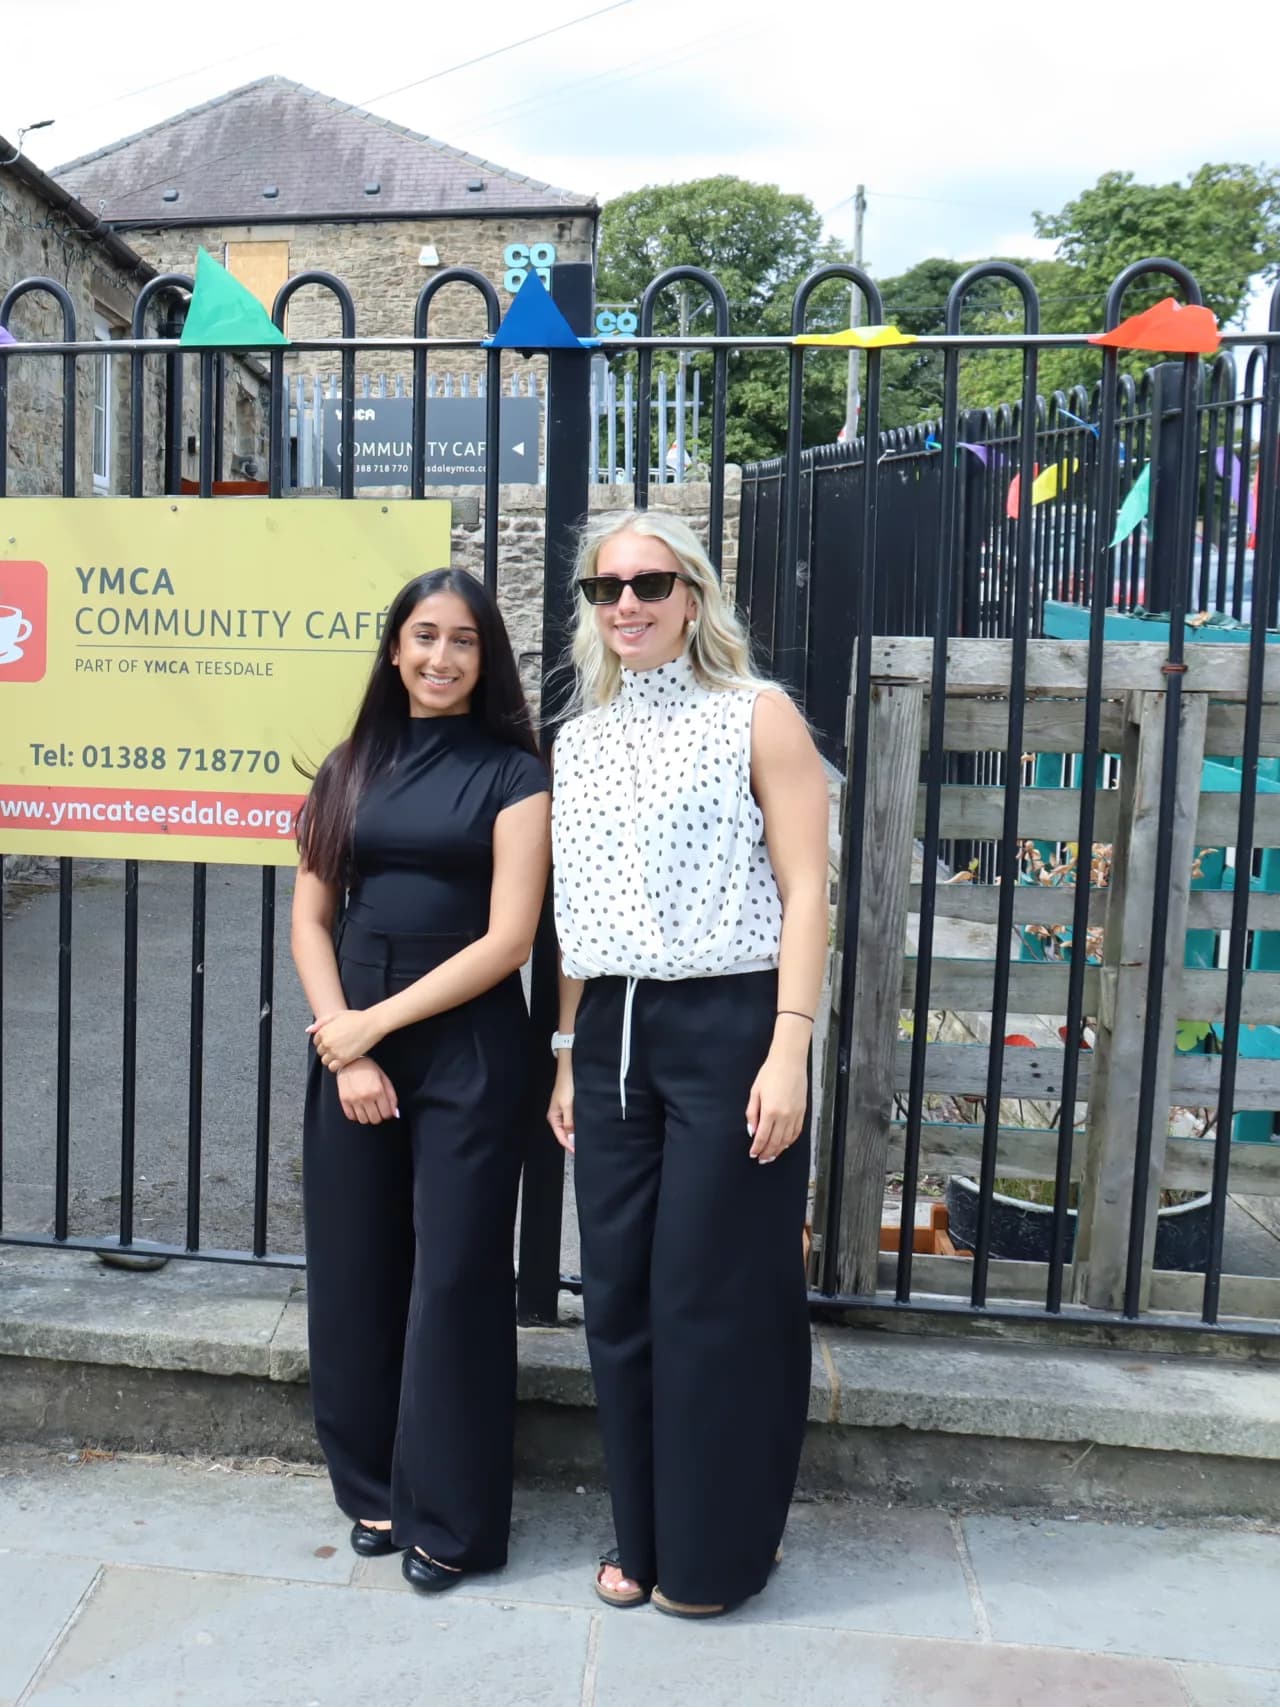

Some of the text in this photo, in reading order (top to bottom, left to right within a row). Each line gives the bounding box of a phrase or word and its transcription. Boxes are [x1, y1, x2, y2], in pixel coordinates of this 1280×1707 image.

[335, 408, 375, 421] YCA
[452, 441, 487, 457] CAF
[391, 464, 408, 473] 770
[75, 566, 175, 596] YMCA
[75, 606, 292, 639] COMMUNITY
[75, 658, 274, 677] PART OF YMCA TEESDALE
[29, 743, 281, 774] Tel: 01388 718770
